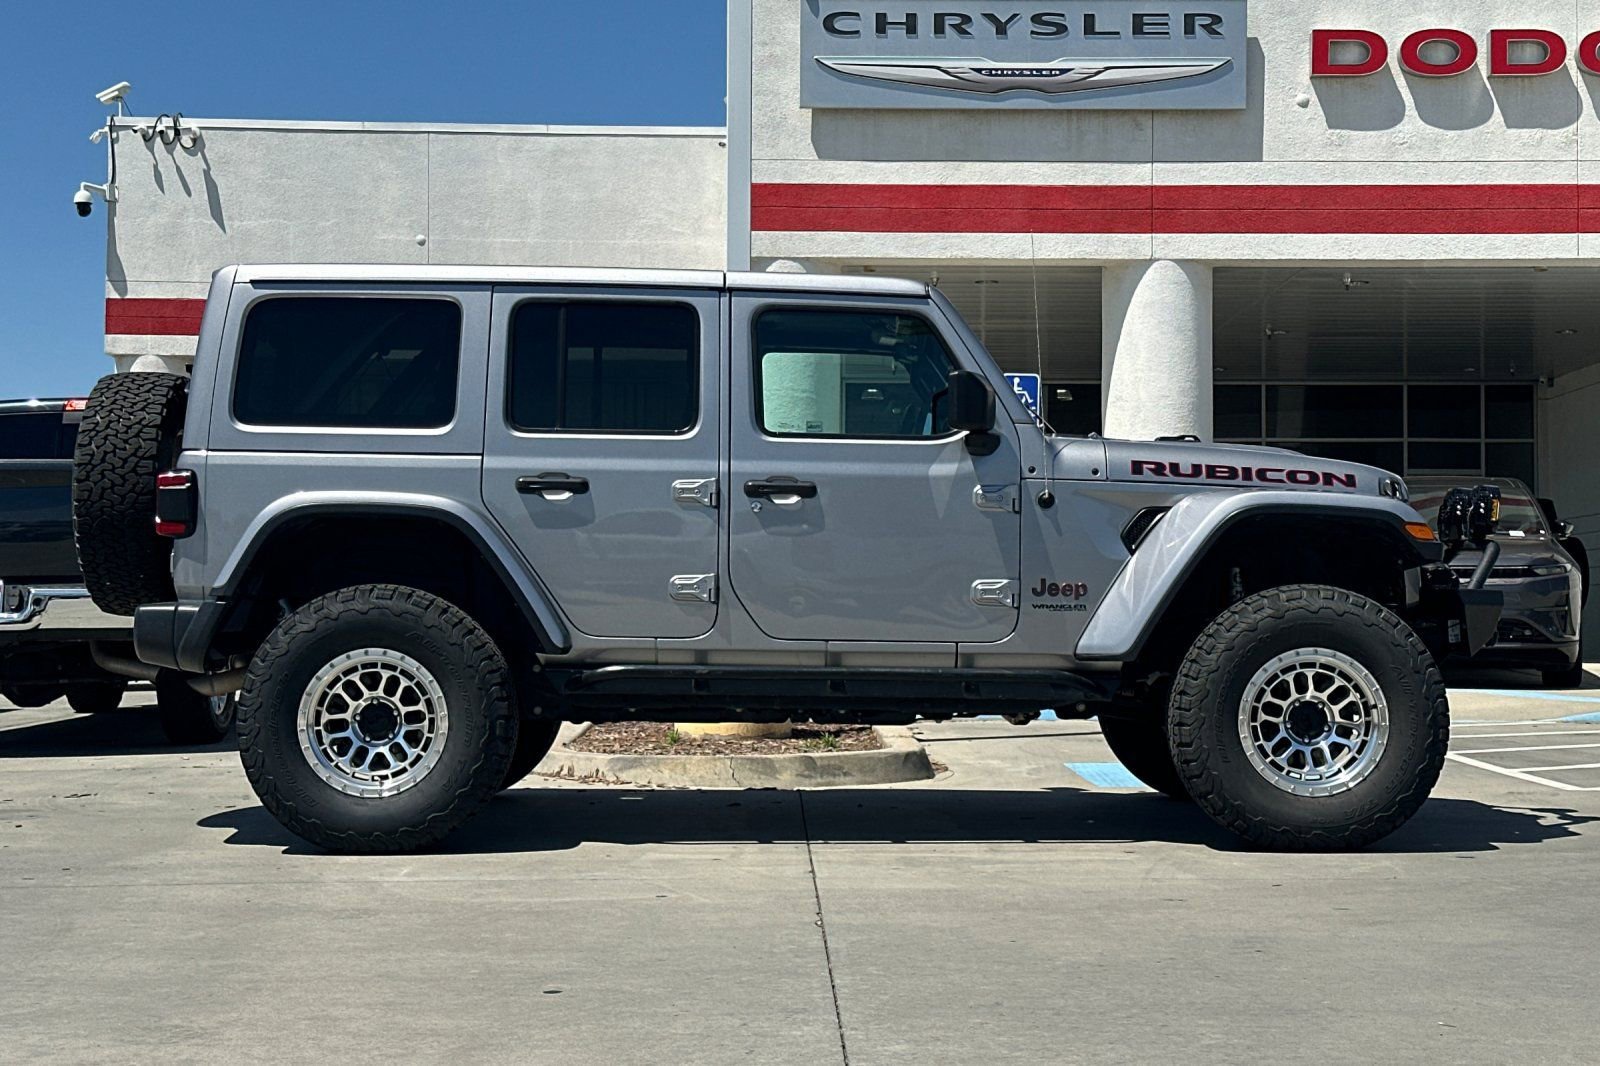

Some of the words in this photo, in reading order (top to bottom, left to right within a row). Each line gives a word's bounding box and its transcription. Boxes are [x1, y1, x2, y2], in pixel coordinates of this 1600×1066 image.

[822, 12, 1225, 37] CHRYSLER
[1311, 29, 1600, 76] DOD
[1131, 460, 1357, 488] RUBICON
[1031, 578, 1088, 600] Jeep
